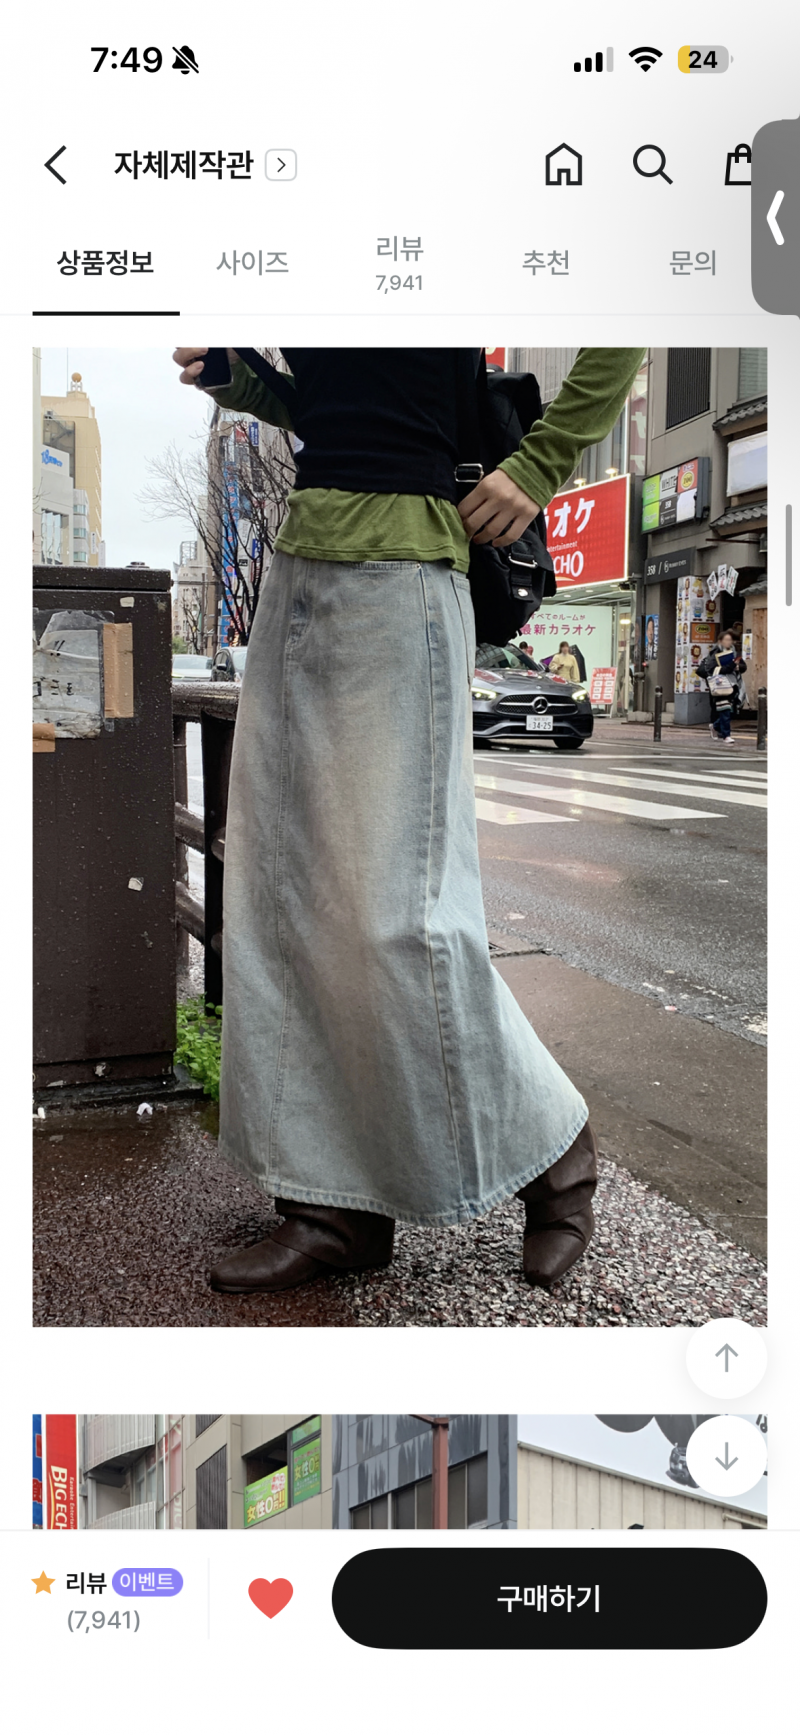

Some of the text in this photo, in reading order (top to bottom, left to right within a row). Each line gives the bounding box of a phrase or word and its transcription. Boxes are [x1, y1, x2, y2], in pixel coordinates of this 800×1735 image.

[90, 46, 163, 73] 7:49
[687, 49, 718, 69] 24
[113, 149, 254, 181] 자체제작관
[375, 235, 424, 262] 리뷰
[56, 249, 154, 277] 상품정보
[216, 249, 289, 276] 사이즈
[522, 249, 570, 276] 추천
[669, 249, 717, 276] 문의
[375, 274, 424, 295] 7,941
[552, 550, 584, 577] CHO
[521, 623, 596, 636] 最新カラオケ
[50, 1465, 68, 1501] BIG
[66, 1571, 174, 1595] 리뷰 이벤트
[496, 1584, 600, 1613] 구매하기
[67, 1609, 141, 1634] (7,941)
